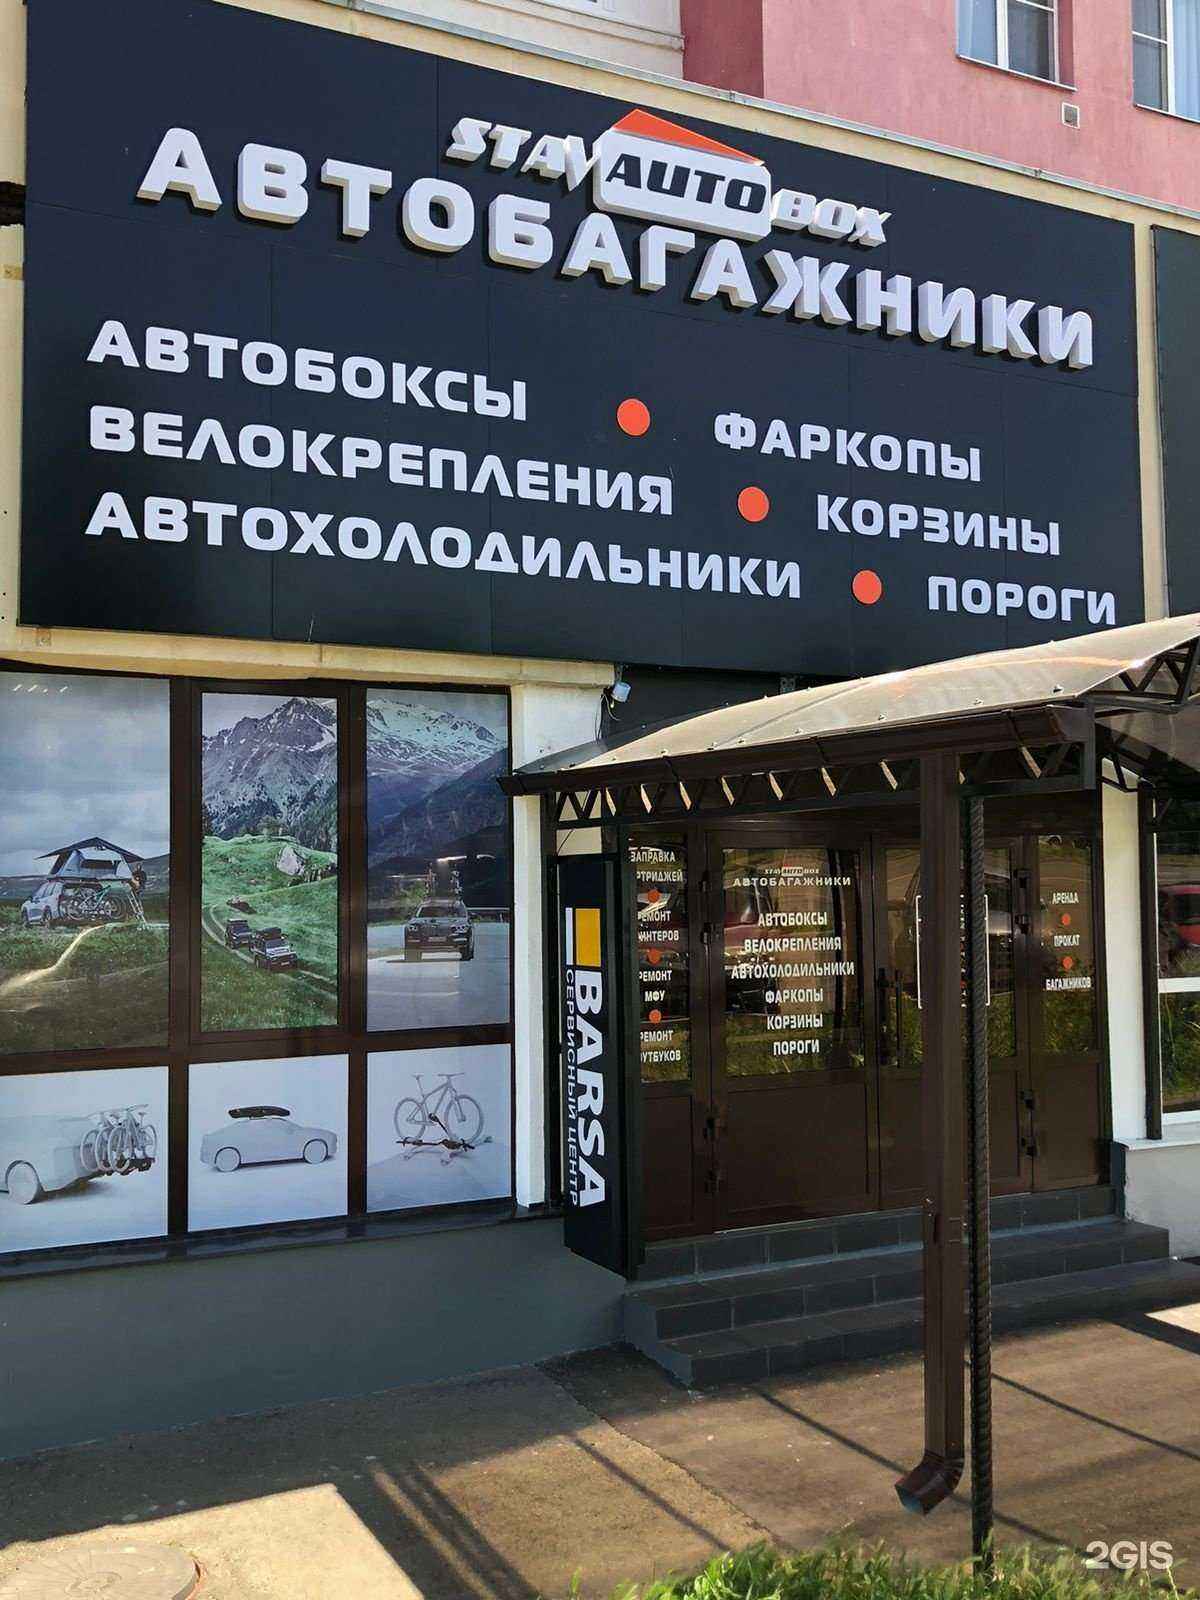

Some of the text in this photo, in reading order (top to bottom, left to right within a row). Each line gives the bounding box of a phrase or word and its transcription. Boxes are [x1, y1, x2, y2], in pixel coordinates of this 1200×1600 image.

[445, 117, 892, 248] STAV AUTO BOX
[136, 127, 1093, 369] АВТОБАГАЖНИКИ
[86, 320, 982, 482] АВТОБОКСЫ ФАРКОПЫ
[89, 405, 1060, 556] ВЕЛОКРЕПЛЕНИЯ КОРЗИНЫ
[85, 492, 1117, 625] АВТОХОЛОДИЛЬНИКИ ПОРОГИ
[732, 876, 851, 887] АВТОБАГАЖНИКИ
[1052, 892, 1079, 905] АРЕНДА
[758, 912, 828, 927] АВТОБОКСЫ
[744, 937, 841, 953] ВЕЛОКРЕПЛЕНИЯ
[1053, 934, 1080, 948] ПРОКАТ
[731, 962, 855, 980] АВТОХОЛОДИЛЬНИКИ
[1045, 977, 1092, 991] БАГАЖНИКОВ
[644, 990, 666, 1002] МФУ
[765, 988, 823, 1005] ФАРКОПЫ
[767, 1014, 823, 1030] КОРЗИНЫ
[773, 1039, 820, 1056] ПОРОГИ
[566, 969, 578, 1207] СЕРВИСНЫЙ ЦЕНТР
[574, 970, 607, 1208] BARSA
